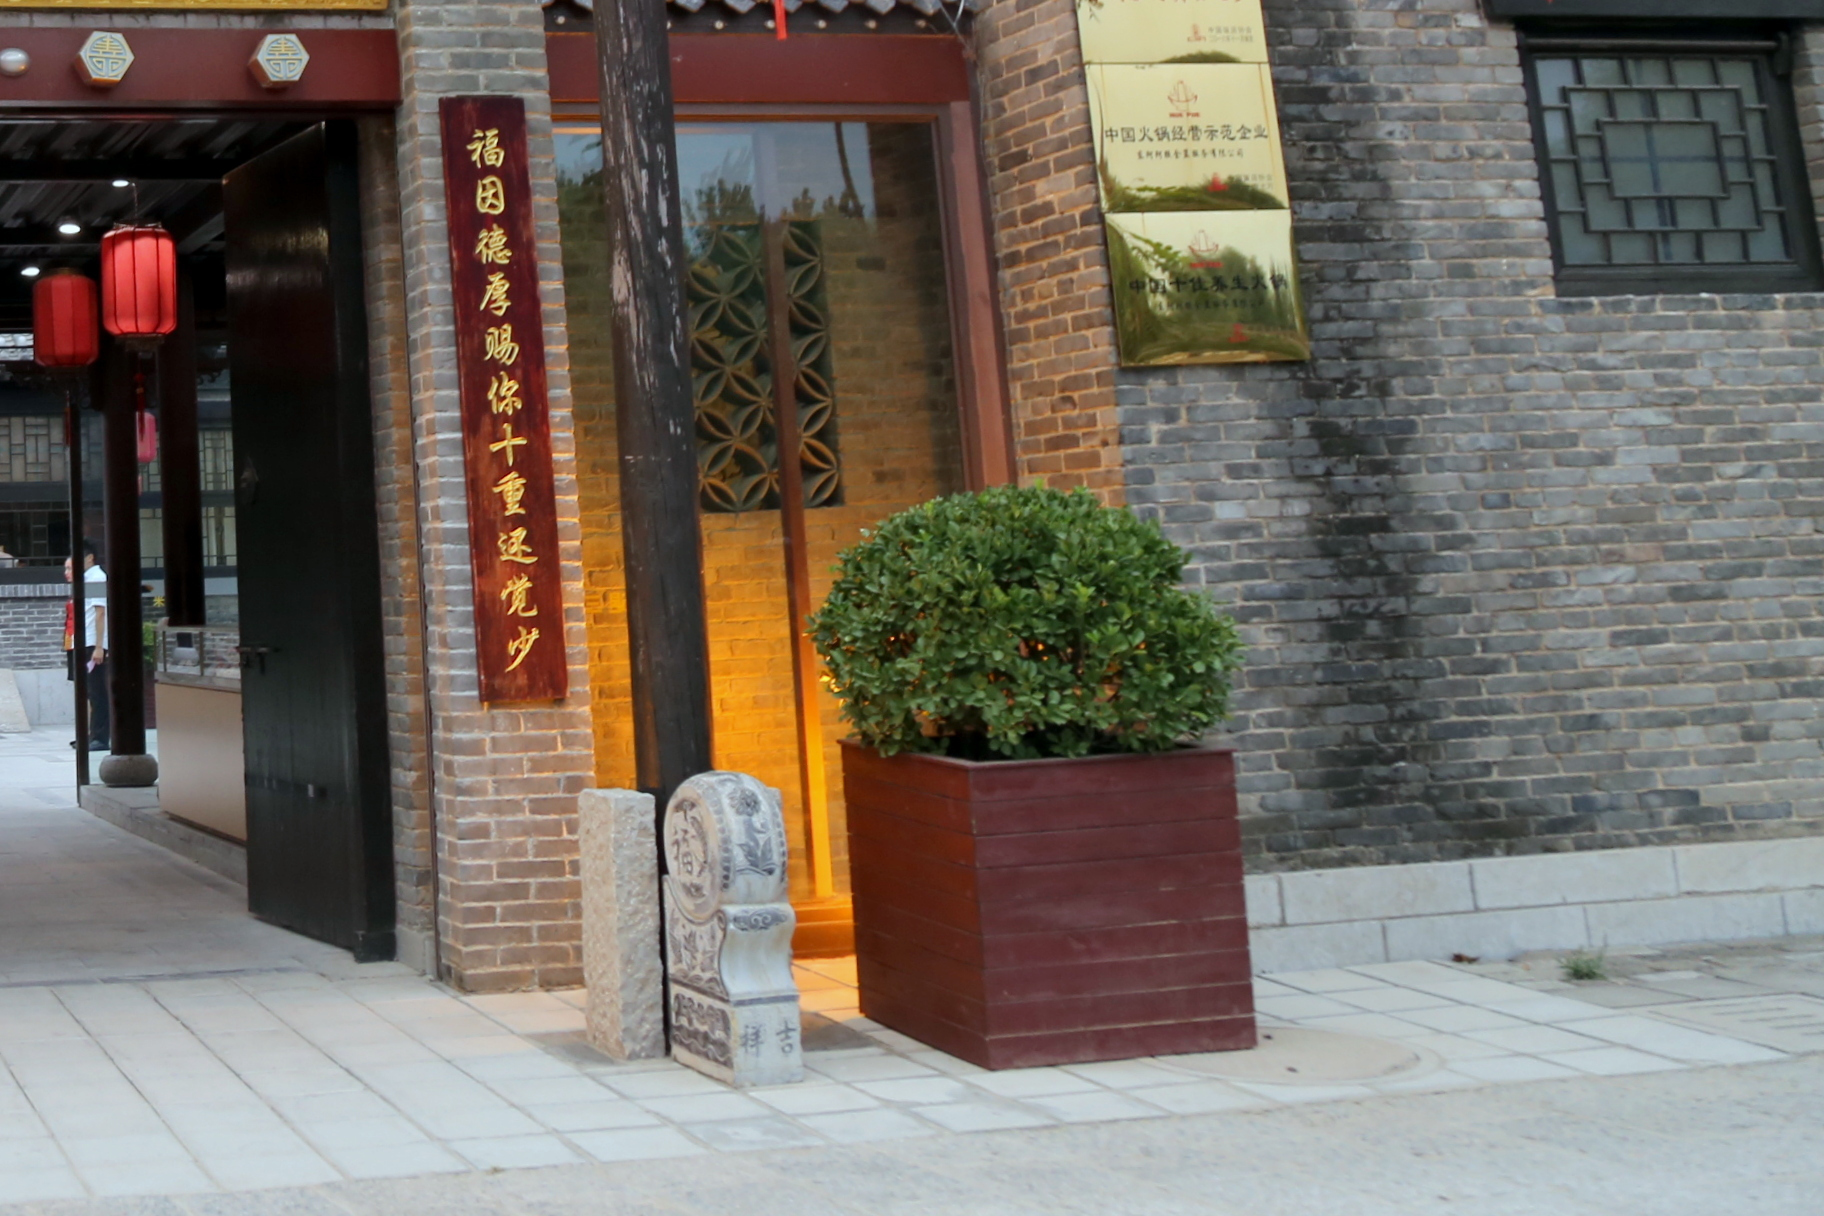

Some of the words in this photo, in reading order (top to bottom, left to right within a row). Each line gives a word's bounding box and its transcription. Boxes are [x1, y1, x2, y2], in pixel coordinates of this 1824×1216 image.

[1105, 124, 1269, 143] 中国火锅经营示范企业
